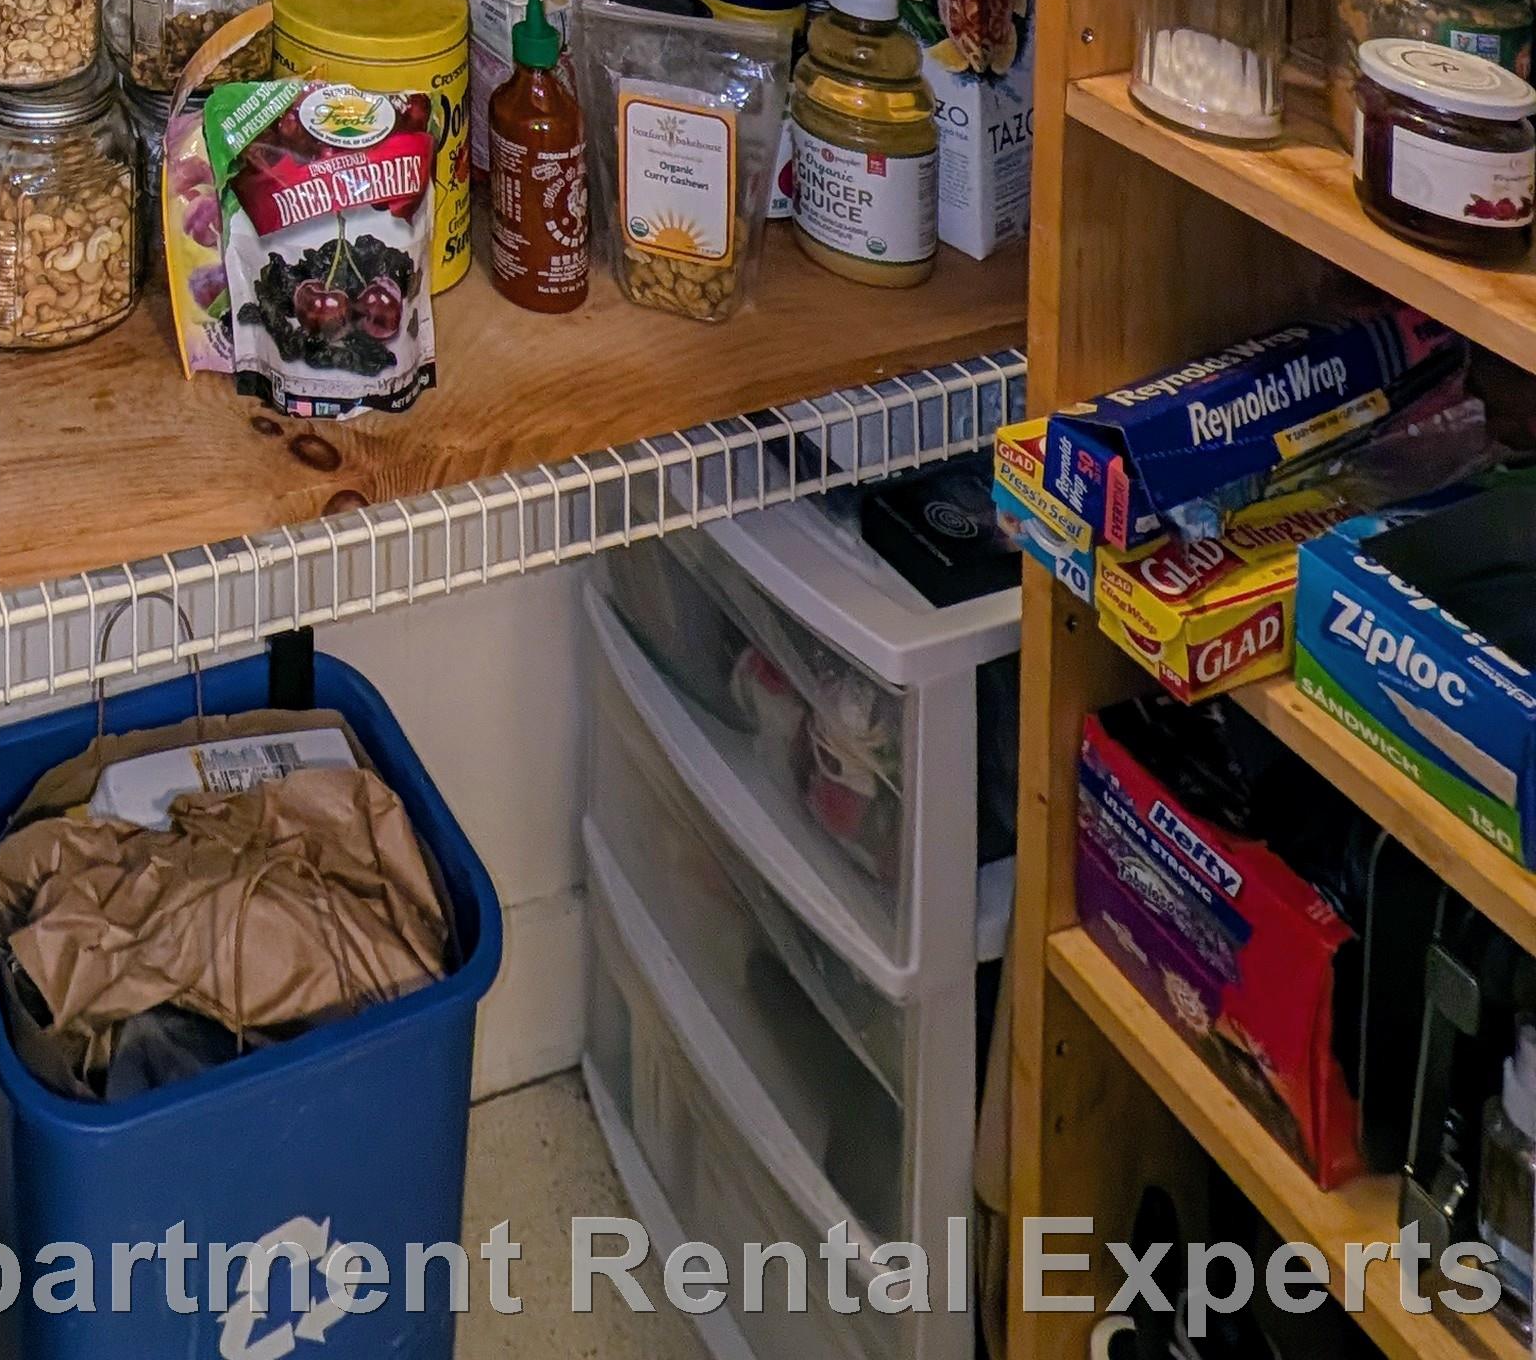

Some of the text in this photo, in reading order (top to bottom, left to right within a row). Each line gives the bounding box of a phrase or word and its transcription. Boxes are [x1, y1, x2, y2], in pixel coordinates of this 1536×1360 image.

[431, 62, 469, 89] CRYST
[221, 117, 236, 133] NO
[234, 96, 262, 121] ADDED
[311, 96, 382, 127] Fresh
[934, 99, 969, 127] ZO
[308, 152, 368, 177] UNSWEETENED
[644, 169, 709, 191] Curry Cashews
[659, 161, 694, 176] Organic
[806, 152, 855, 183] Organic
[272, 155, 422, 227] DRIED CHERRIES
[798, 163, 873, 208] GINGER
[802, 187, 863, 224] JUICE
[1106, 327, 1311, 407] Reynolds Wrap
[1187, 372, 1291, 446] Reynolds
[1283, 354, 1347, 402] Wrap
[998, 442, 1034, 472] GLAD
[1056, 435, 1073, 501] Reynolds
[1077, 449, 1096, 480] 50
[1048, 505, 1084, 538] Seal
[1225, 502, 1359, 551] ClingWra
[1059, 557, 1086, 592] 70
[1102, 568, 1132, 594] GLAD
[1140, 537, 1225, 596] GLAD
[1101, 581, 1157, 636] ClingWrap
[1196, 615, 1280, 683] GLAD
[1329, 590, 1466, 707] Ziploc
[1302, 677, 1421, 781] SANDWICH
[1103, 790, 1215, 904] ULTRA STRONG
[1154, 805, 1237, 892] Hefty
[1466, 807, 1515, 854] 150
